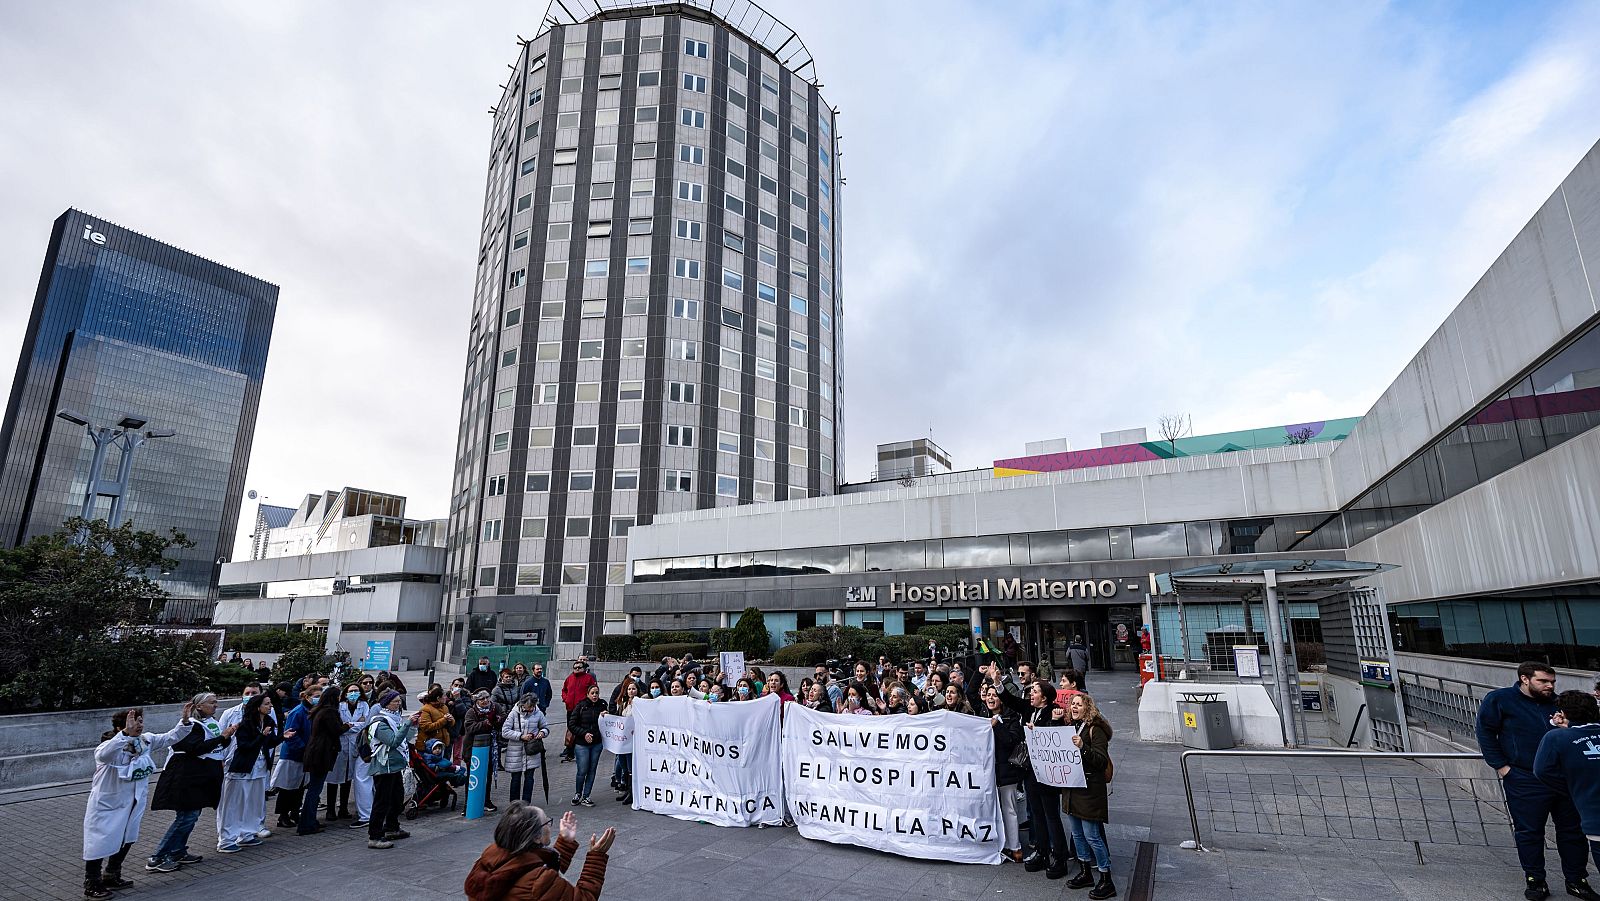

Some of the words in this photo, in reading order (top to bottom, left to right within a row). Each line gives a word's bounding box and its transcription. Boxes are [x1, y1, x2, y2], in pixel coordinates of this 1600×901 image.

[83, 224, 106, 245] ie
[890, 579, 989, 605] Hospital
[997, 578, 1117, 601] Materno
[647, 729, 740, 759] SALVEMOS
[812, 730, 947, 752] SALVEMOS
[1031, 730, 1062, 748] APOYO
[650, 758, 669, 773] LA
[1037, 749, 1082, 765] ADJUNTOS
[799, 762, 826, 780] EL
[839, 765, 981, 790] HOSPITAL
[644, 786, 776, 815] PEDIÁTRICA
[795, 800, 883, 831] INFANTIL
[895, 816, 926, 835] LA
[941, 817, 994, 843] PAZ
